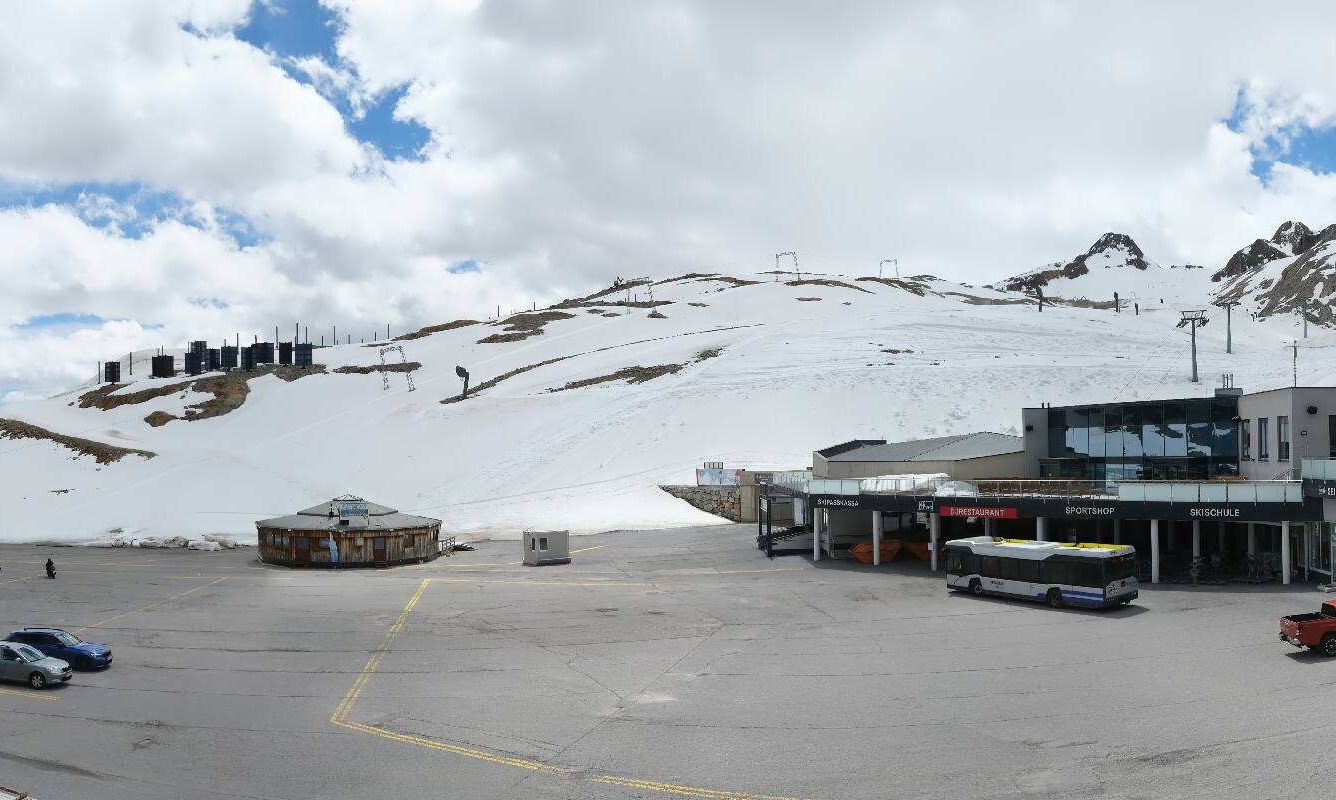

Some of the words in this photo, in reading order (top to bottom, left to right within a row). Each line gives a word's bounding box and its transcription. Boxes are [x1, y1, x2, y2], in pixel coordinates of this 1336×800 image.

[958, 507, 1005, 517] RESTAURANT
[1065, 506, 1115, 516] SPORTSHOP
[1190, 508, 1240, 517] SKISCHULE
